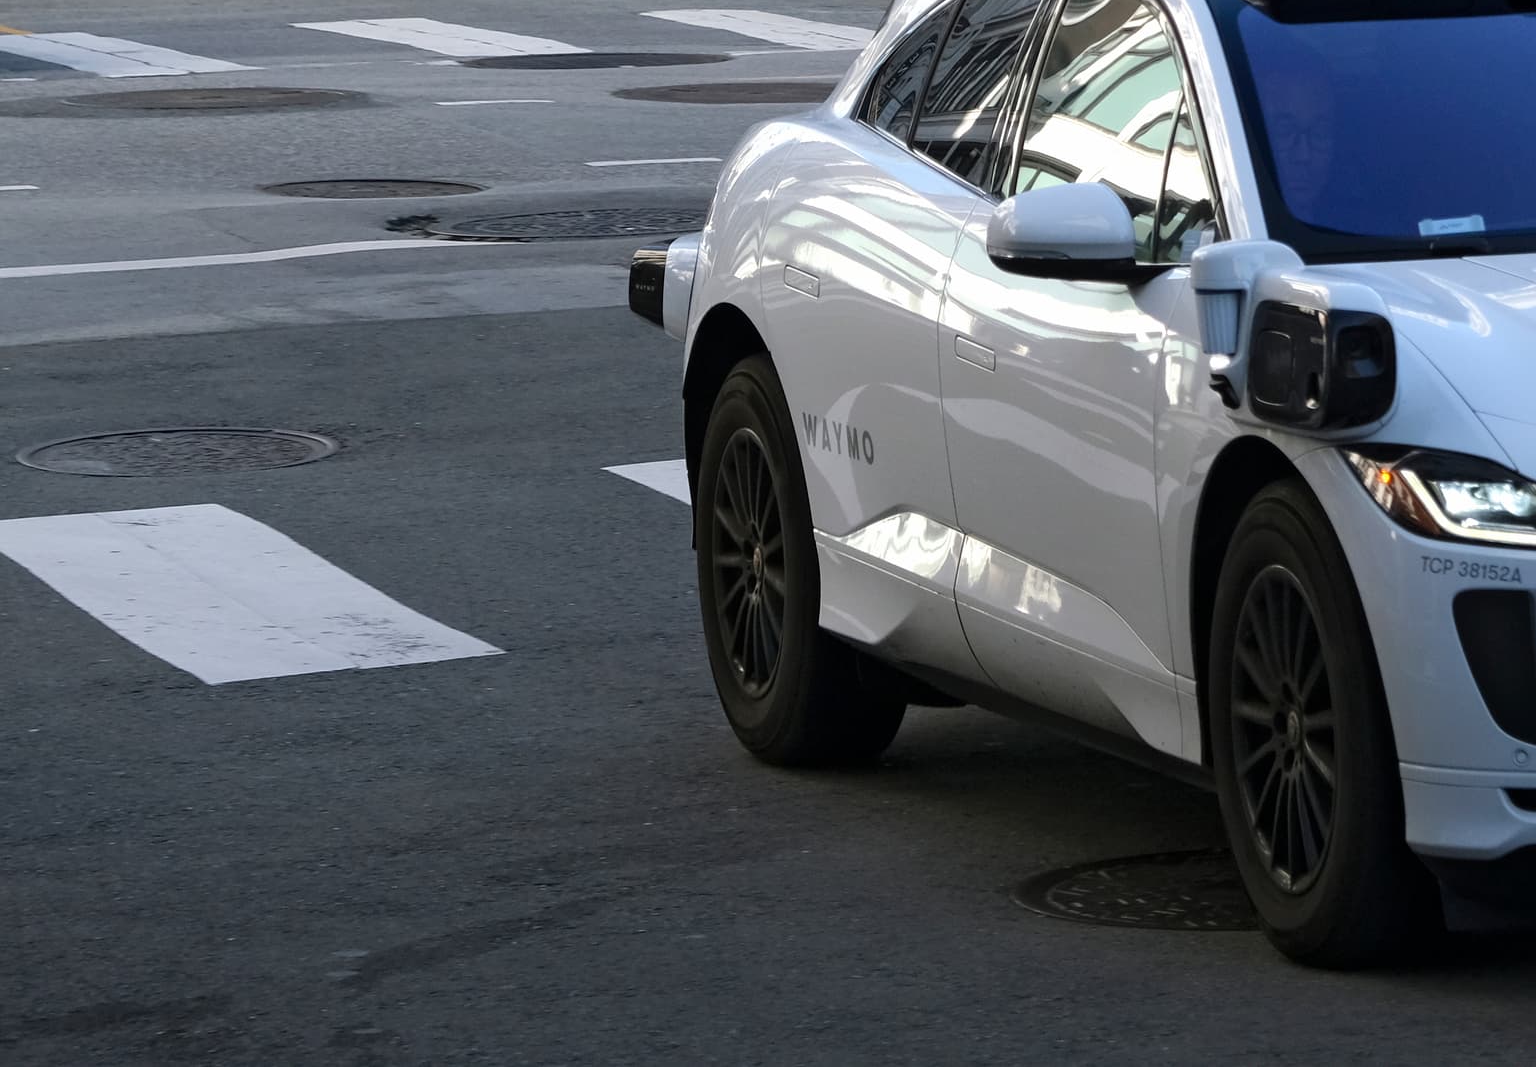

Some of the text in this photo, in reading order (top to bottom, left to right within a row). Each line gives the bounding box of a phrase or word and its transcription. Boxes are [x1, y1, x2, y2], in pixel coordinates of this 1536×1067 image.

[801, 411, 875, 466] WAYMO
[1420, 555, 1522, 583] TCP 38152A
